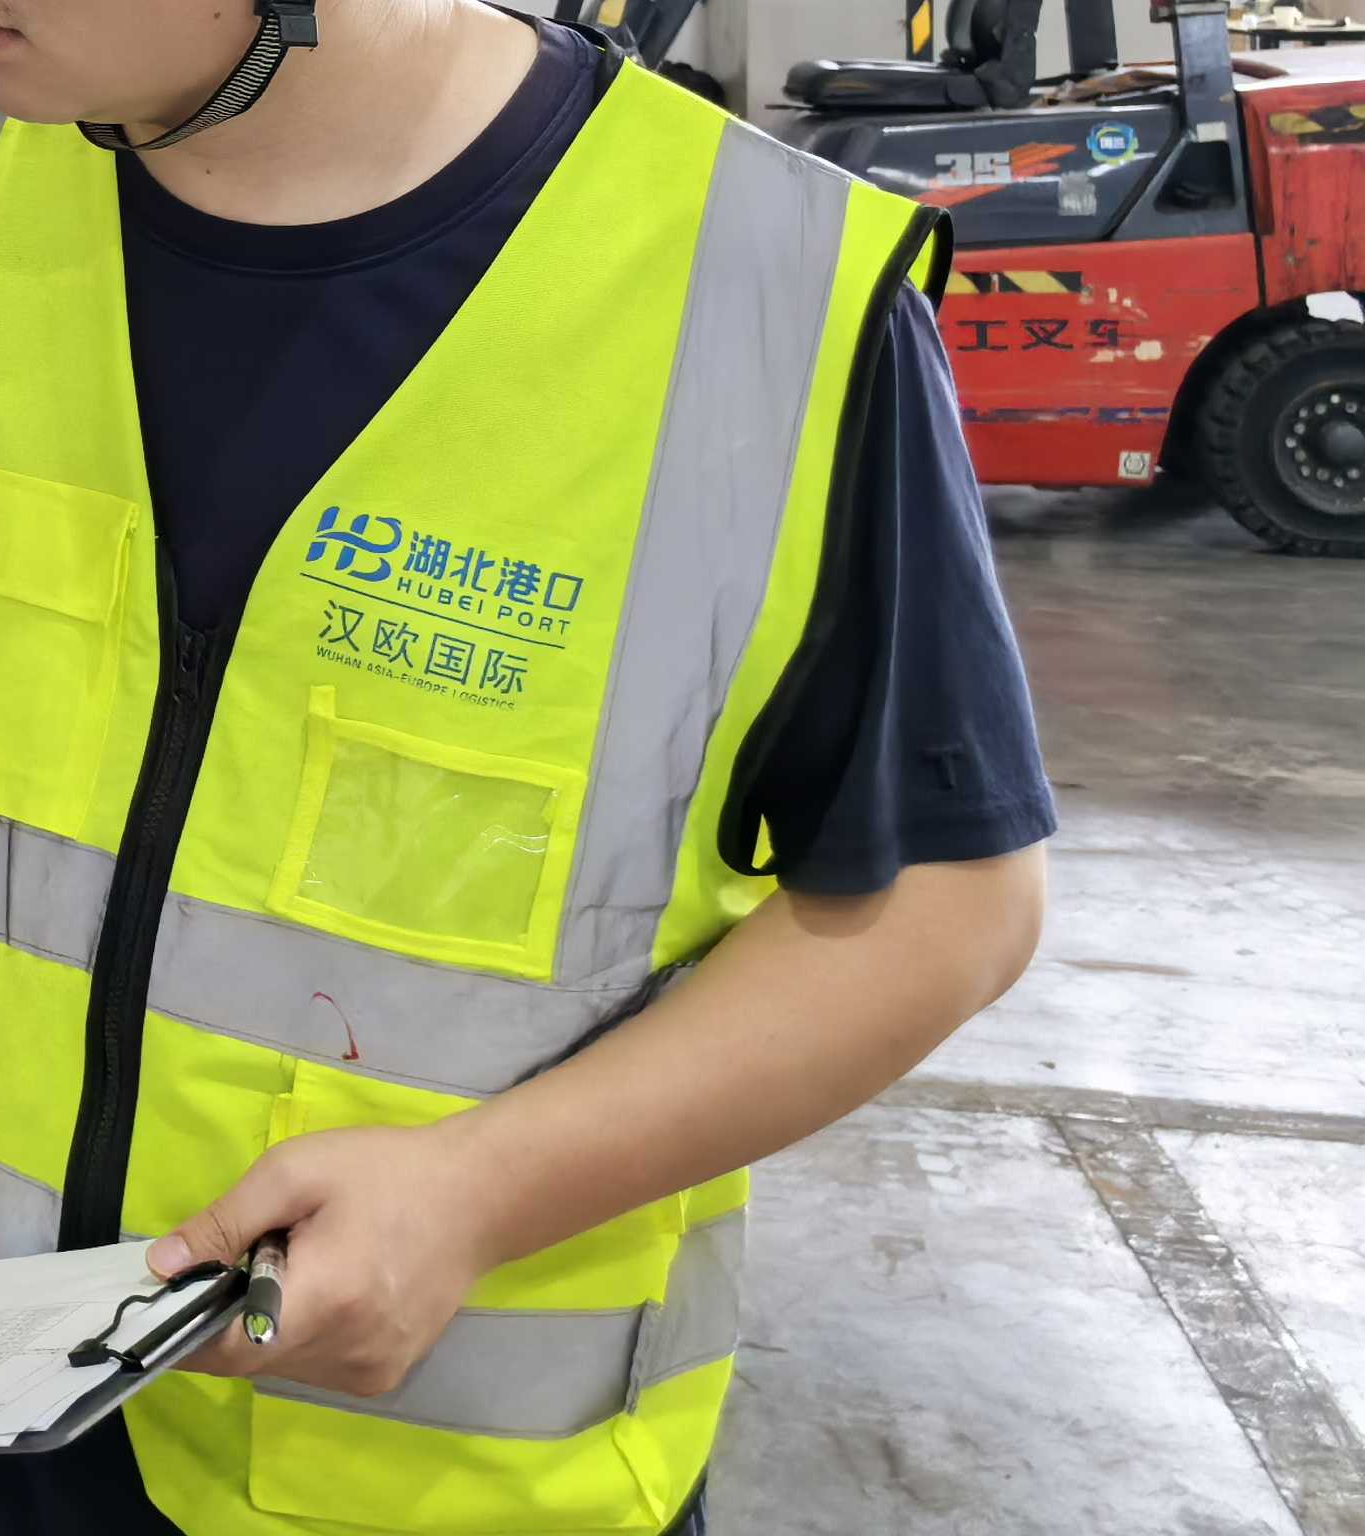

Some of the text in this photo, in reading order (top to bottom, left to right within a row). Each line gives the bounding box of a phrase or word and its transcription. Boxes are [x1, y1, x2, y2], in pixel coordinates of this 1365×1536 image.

[396, 576, 572, 636] HUBEI PORT
[402, 530, 584, 612] 湖北港口
[316, 645, 362, 670] WUHAN
[318, 599, 529, 695] 汉欧国际
